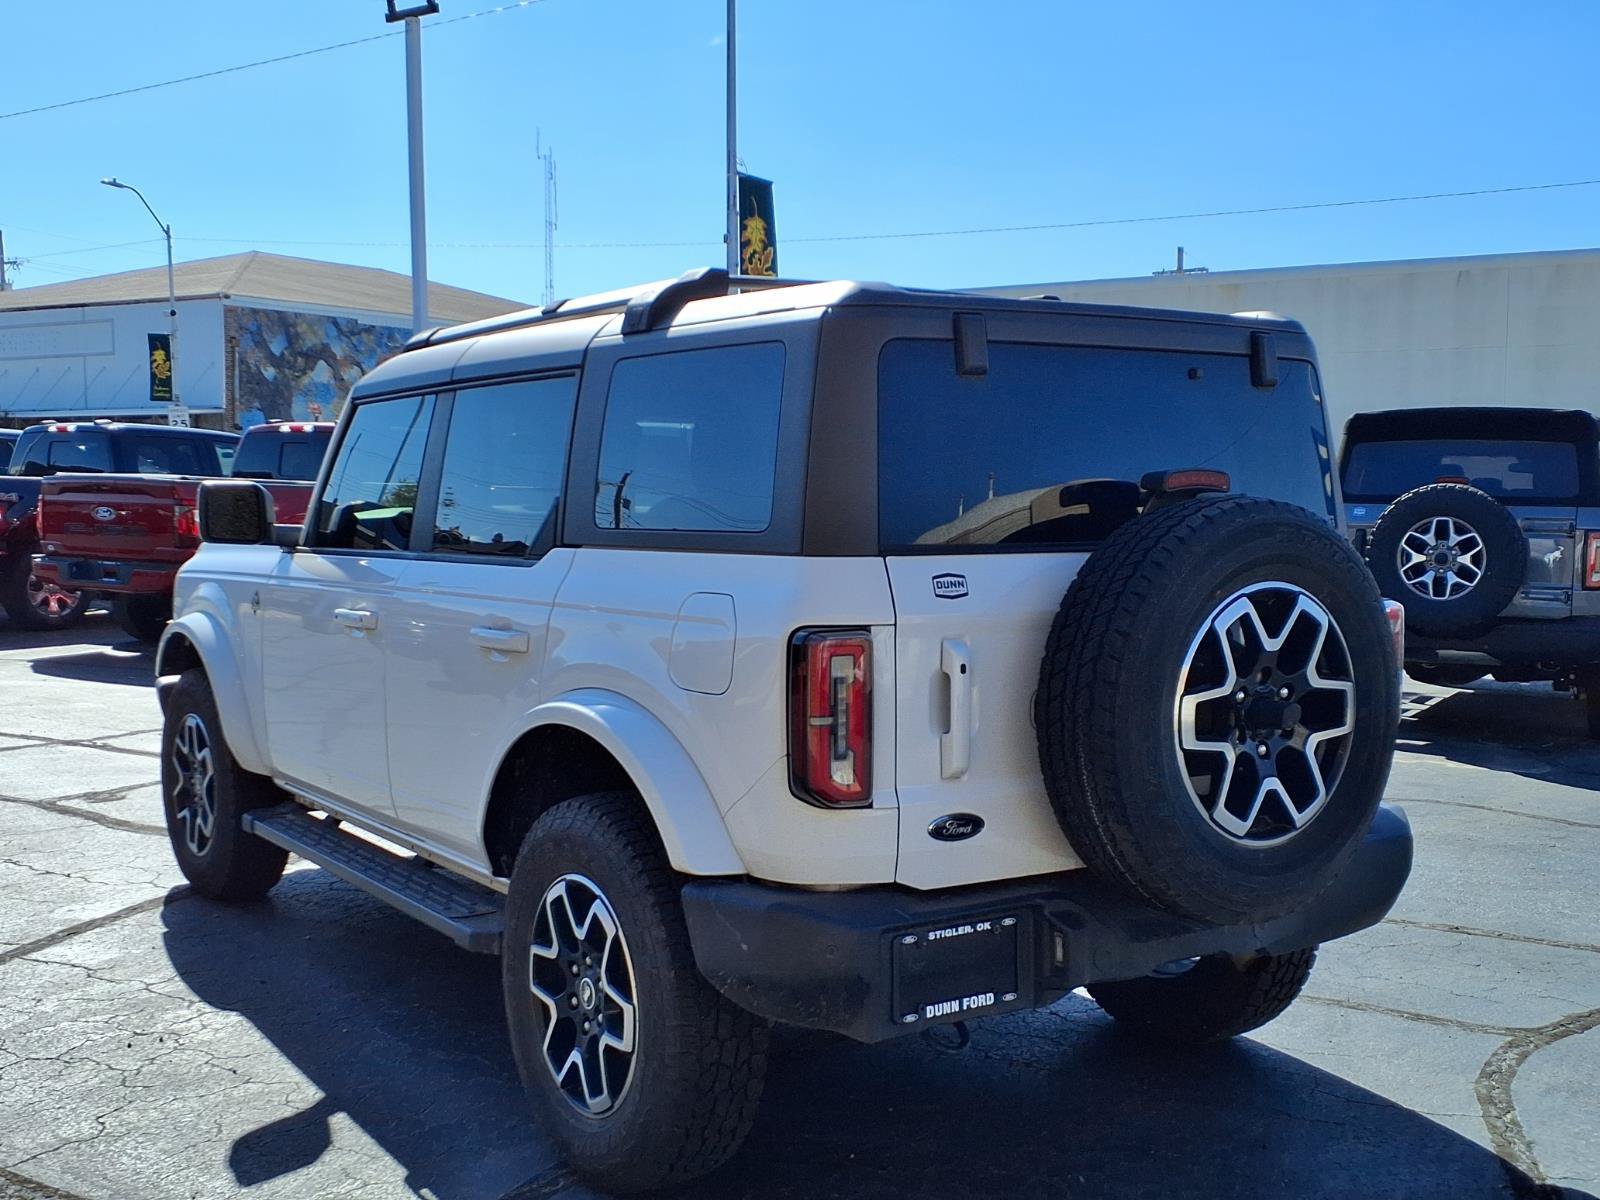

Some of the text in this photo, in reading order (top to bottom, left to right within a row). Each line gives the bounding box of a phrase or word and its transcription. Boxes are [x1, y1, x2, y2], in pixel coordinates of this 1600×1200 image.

[936, 580, 965, 589] DUNN
[943, 820, 973, 835] Ford
[976, 922, 992, 931] OK
[926, 999, 960, 1019] DUNN
[962, 992, 995, 1011] FORD
